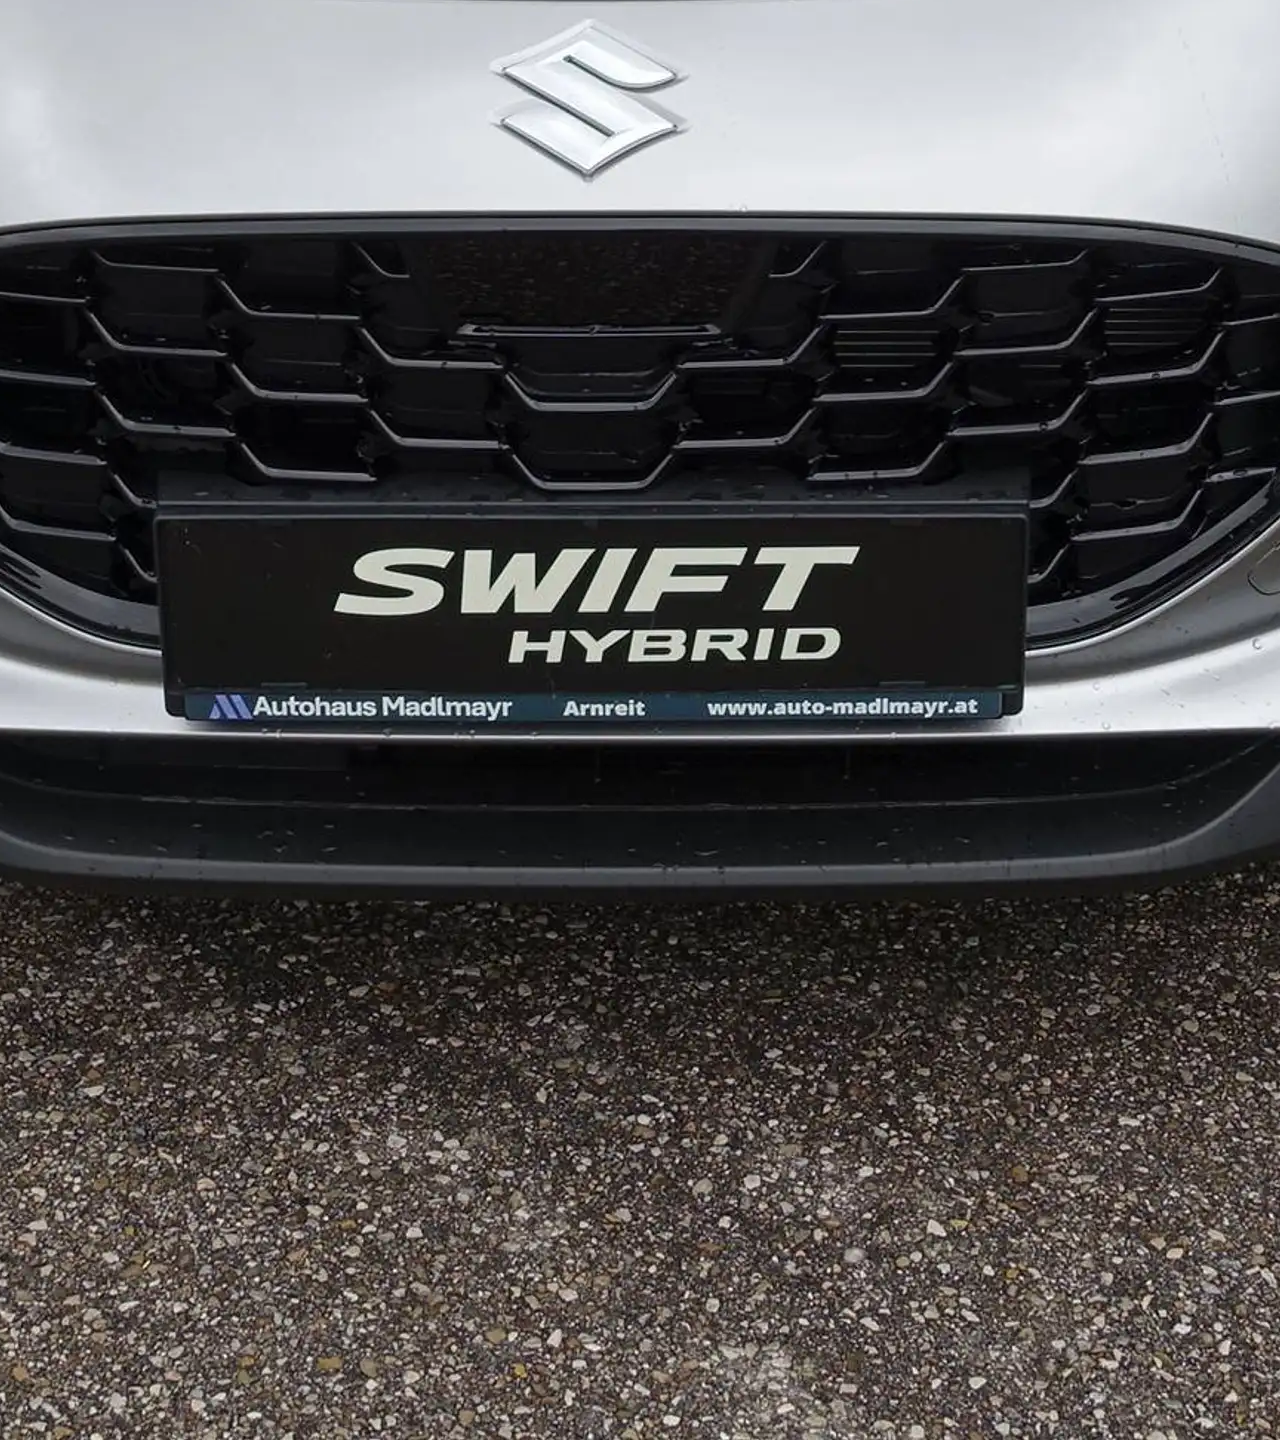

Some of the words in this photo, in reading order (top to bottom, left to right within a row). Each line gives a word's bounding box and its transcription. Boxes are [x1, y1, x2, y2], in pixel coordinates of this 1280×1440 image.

[333, 546, 861, 616] SWIFT
[508, 627, 842, 664] HYBRID
[252, 695, 378, 717] Autohaus
[382, 695, 513, 722] Madlmayr
[563, 699, 646, 717] Arnreit
[707, 697, 979, 719] www.auto-madlmayr.at
